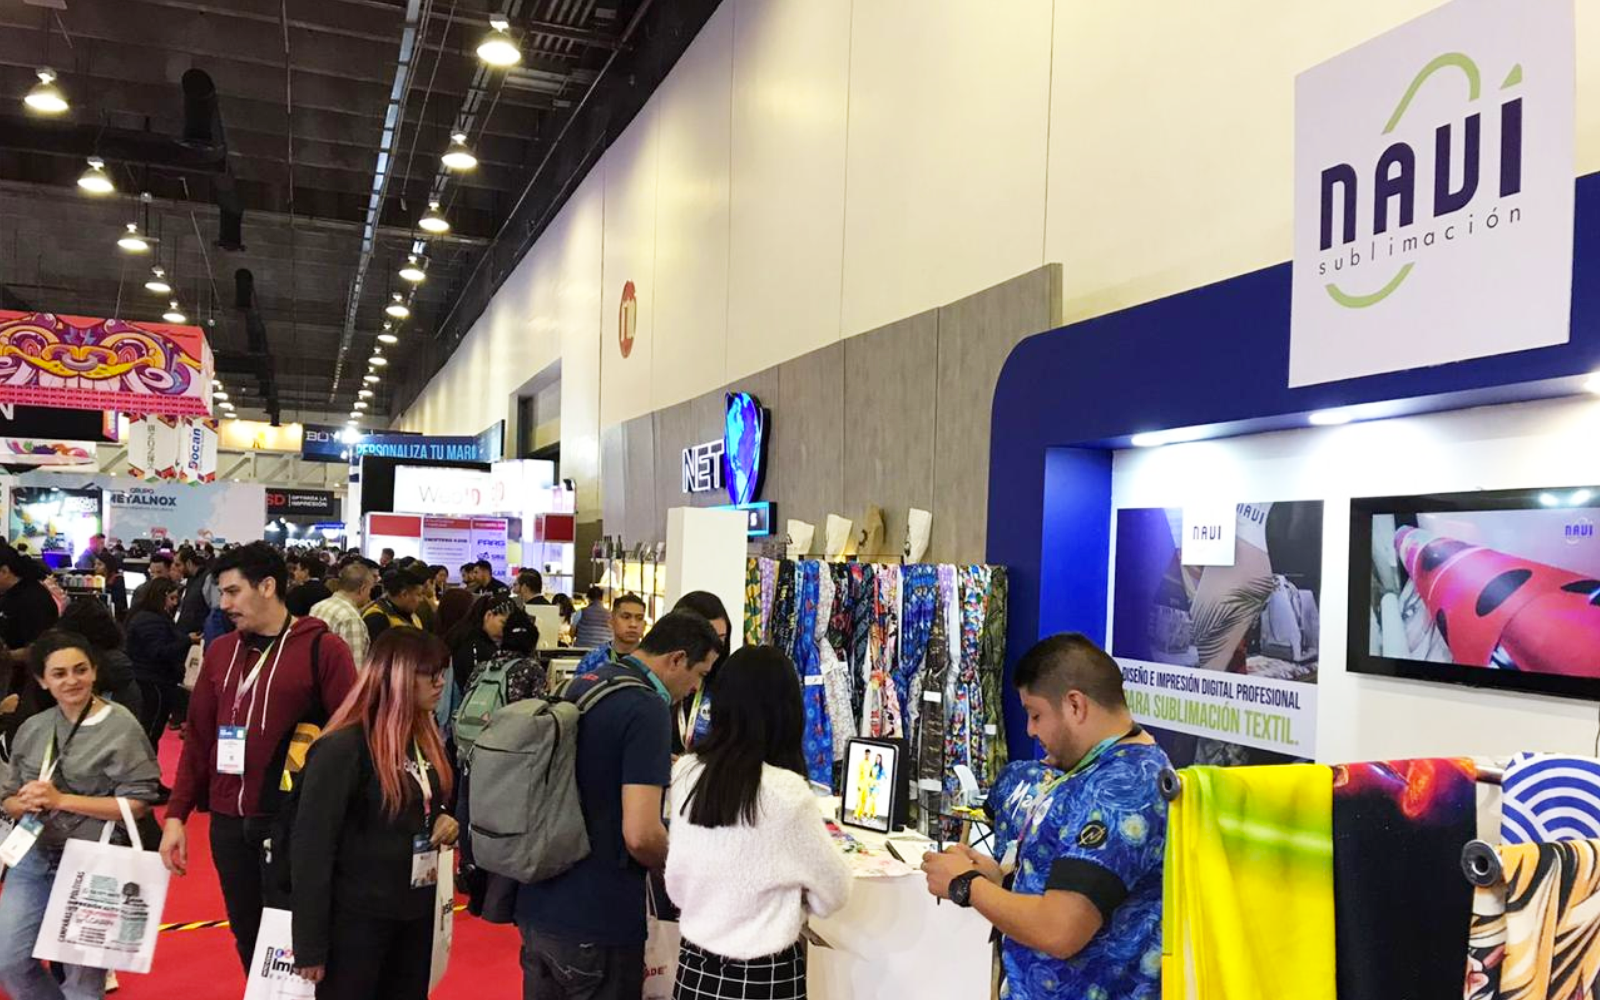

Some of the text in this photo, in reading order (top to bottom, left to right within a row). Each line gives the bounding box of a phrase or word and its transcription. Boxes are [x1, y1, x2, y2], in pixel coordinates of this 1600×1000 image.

[1318, 206, 1522, 276] sublimación
[356, 442, 428, 460] PERSONALIZA
[430, 444, 444, 460] TU
[681, 438, 725, 494] NET
[1149, 671, 1156, 686] E
[1156, 673, 1201, 694] IMPRESIÓN
[1201, 680, 1235, 700] DIGITAL
[1235, 683, 1302, 710] PROFESIONAL
[1152, 694, 1241, 735] SUBLIMACIÓN
[1243, 708, 1301, 746] TEXTIL.
